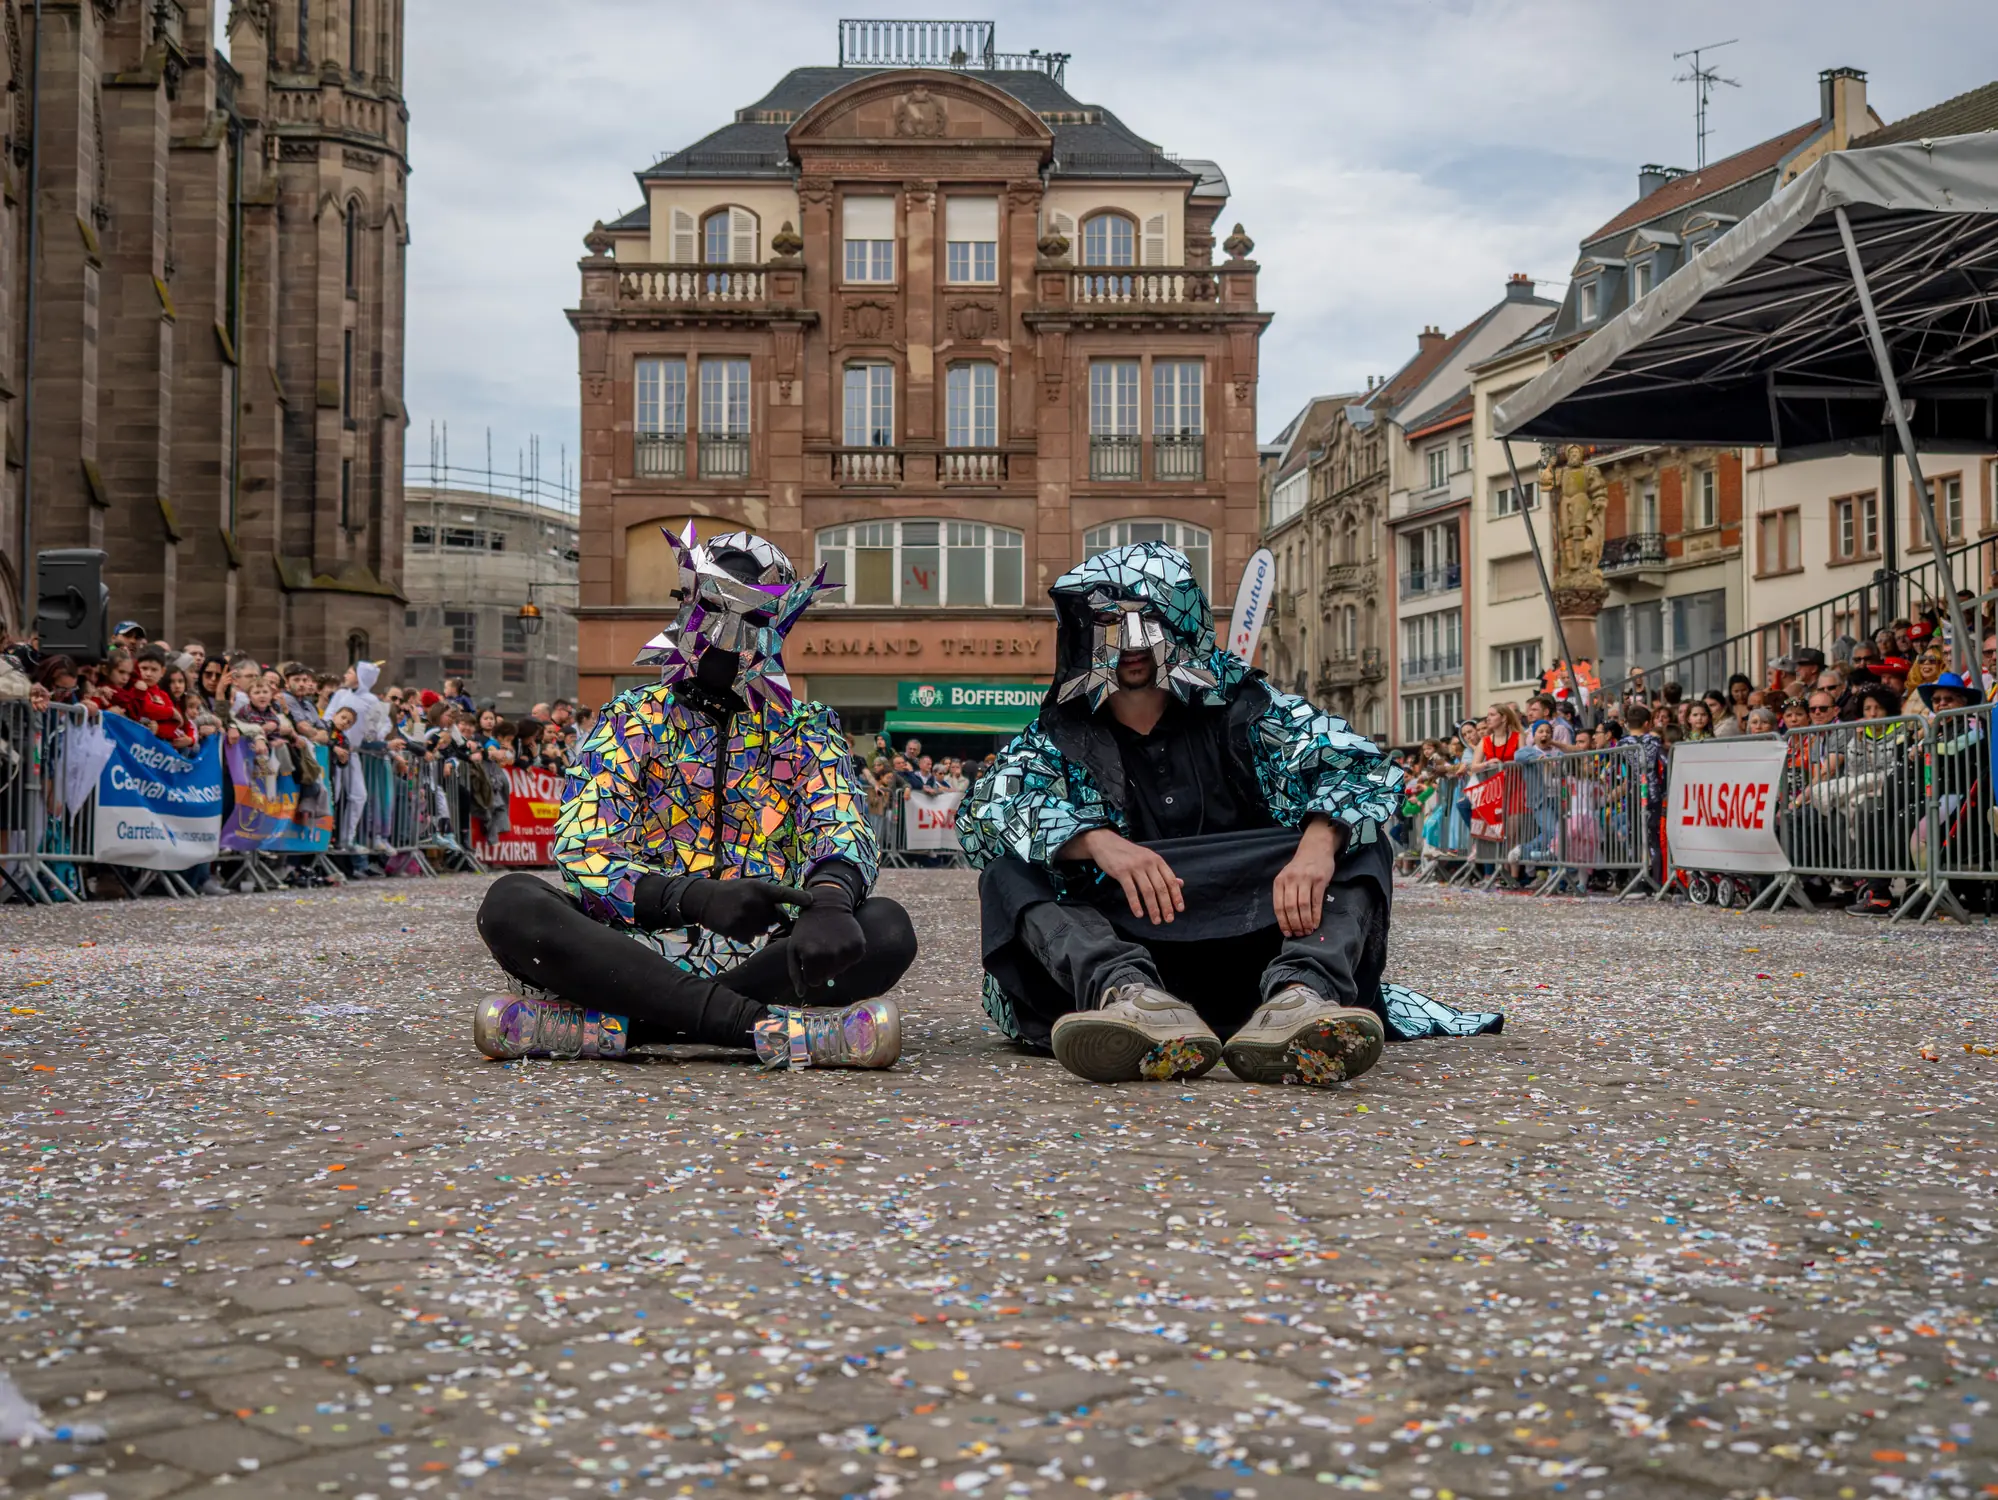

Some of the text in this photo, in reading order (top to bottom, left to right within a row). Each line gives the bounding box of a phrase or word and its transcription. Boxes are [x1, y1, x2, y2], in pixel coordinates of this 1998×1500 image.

[1242, 558, 1268, 631] Mutuel
[802, 638, 1042, 656] ARMAND THIERY
[1682, 783, 1770, 829] L'ALSACE
[476, 841, 538, 861] ALTKIRCH
